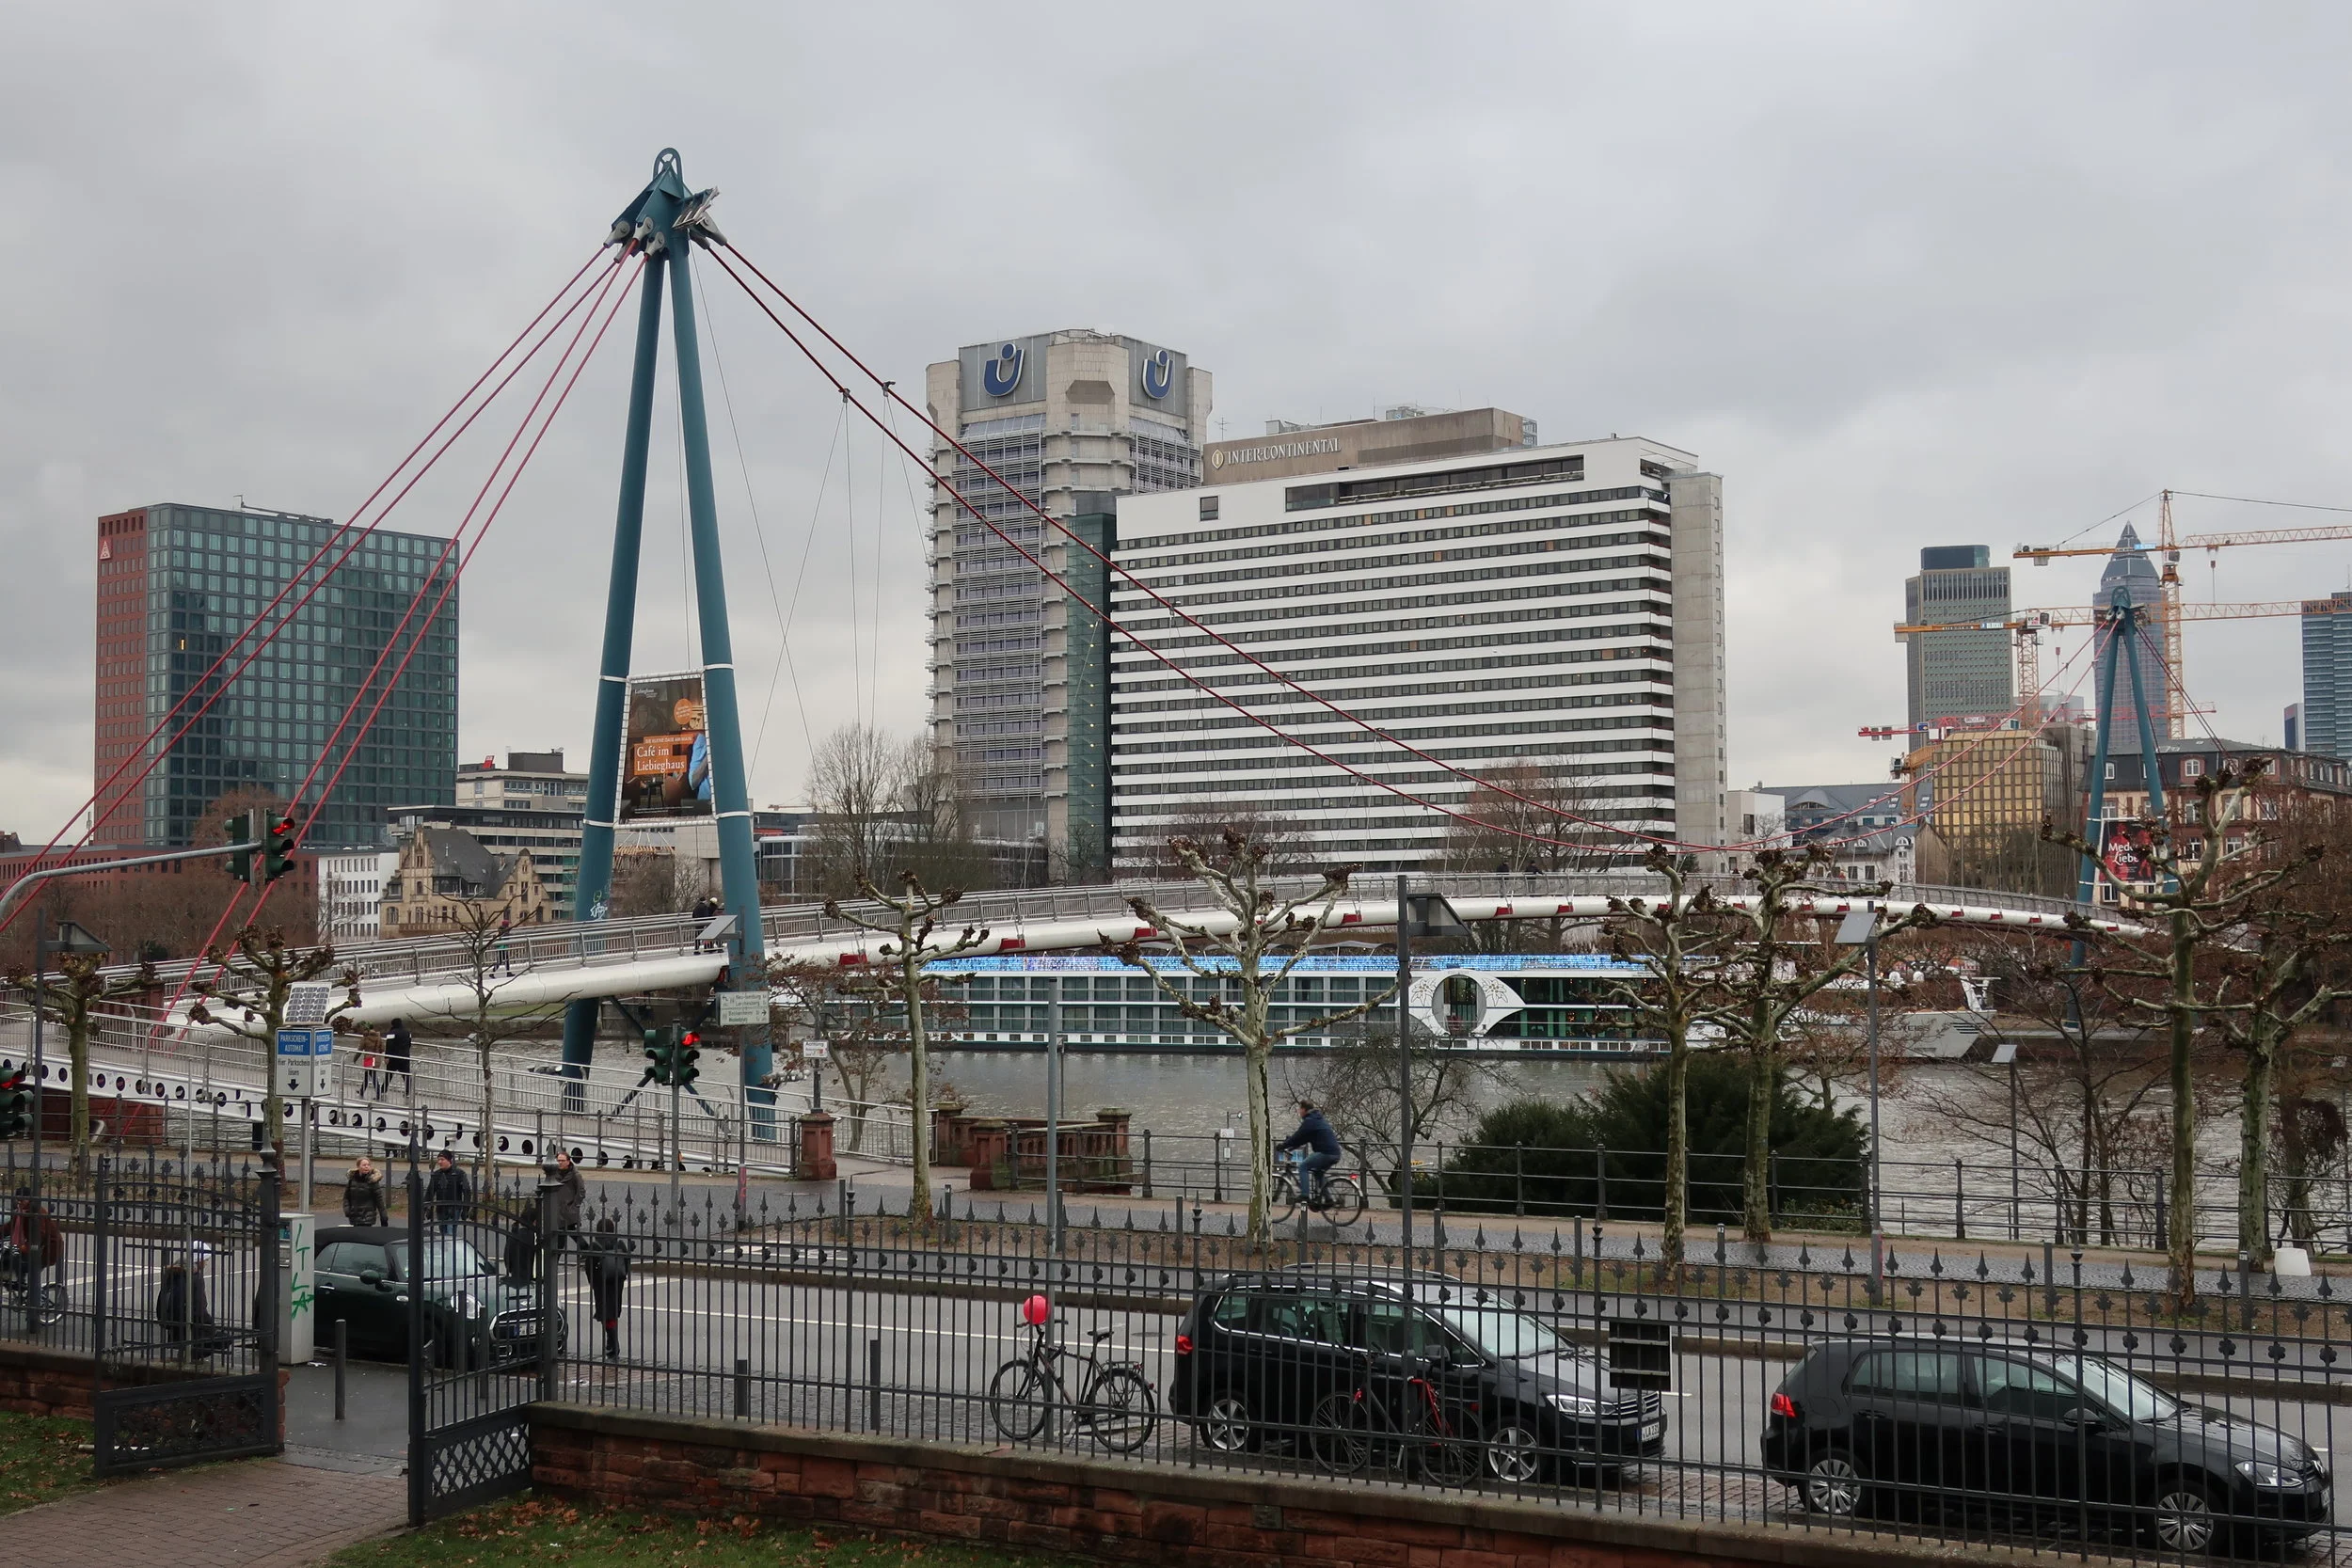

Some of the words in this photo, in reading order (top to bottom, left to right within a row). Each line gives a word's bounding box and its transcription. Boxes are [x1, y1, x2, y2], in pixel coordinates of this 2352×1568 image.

[636, 746, 656, 757] Café
[658, 746, 669, 755] im
[637, 758, 685, 772] Liebieghaus
